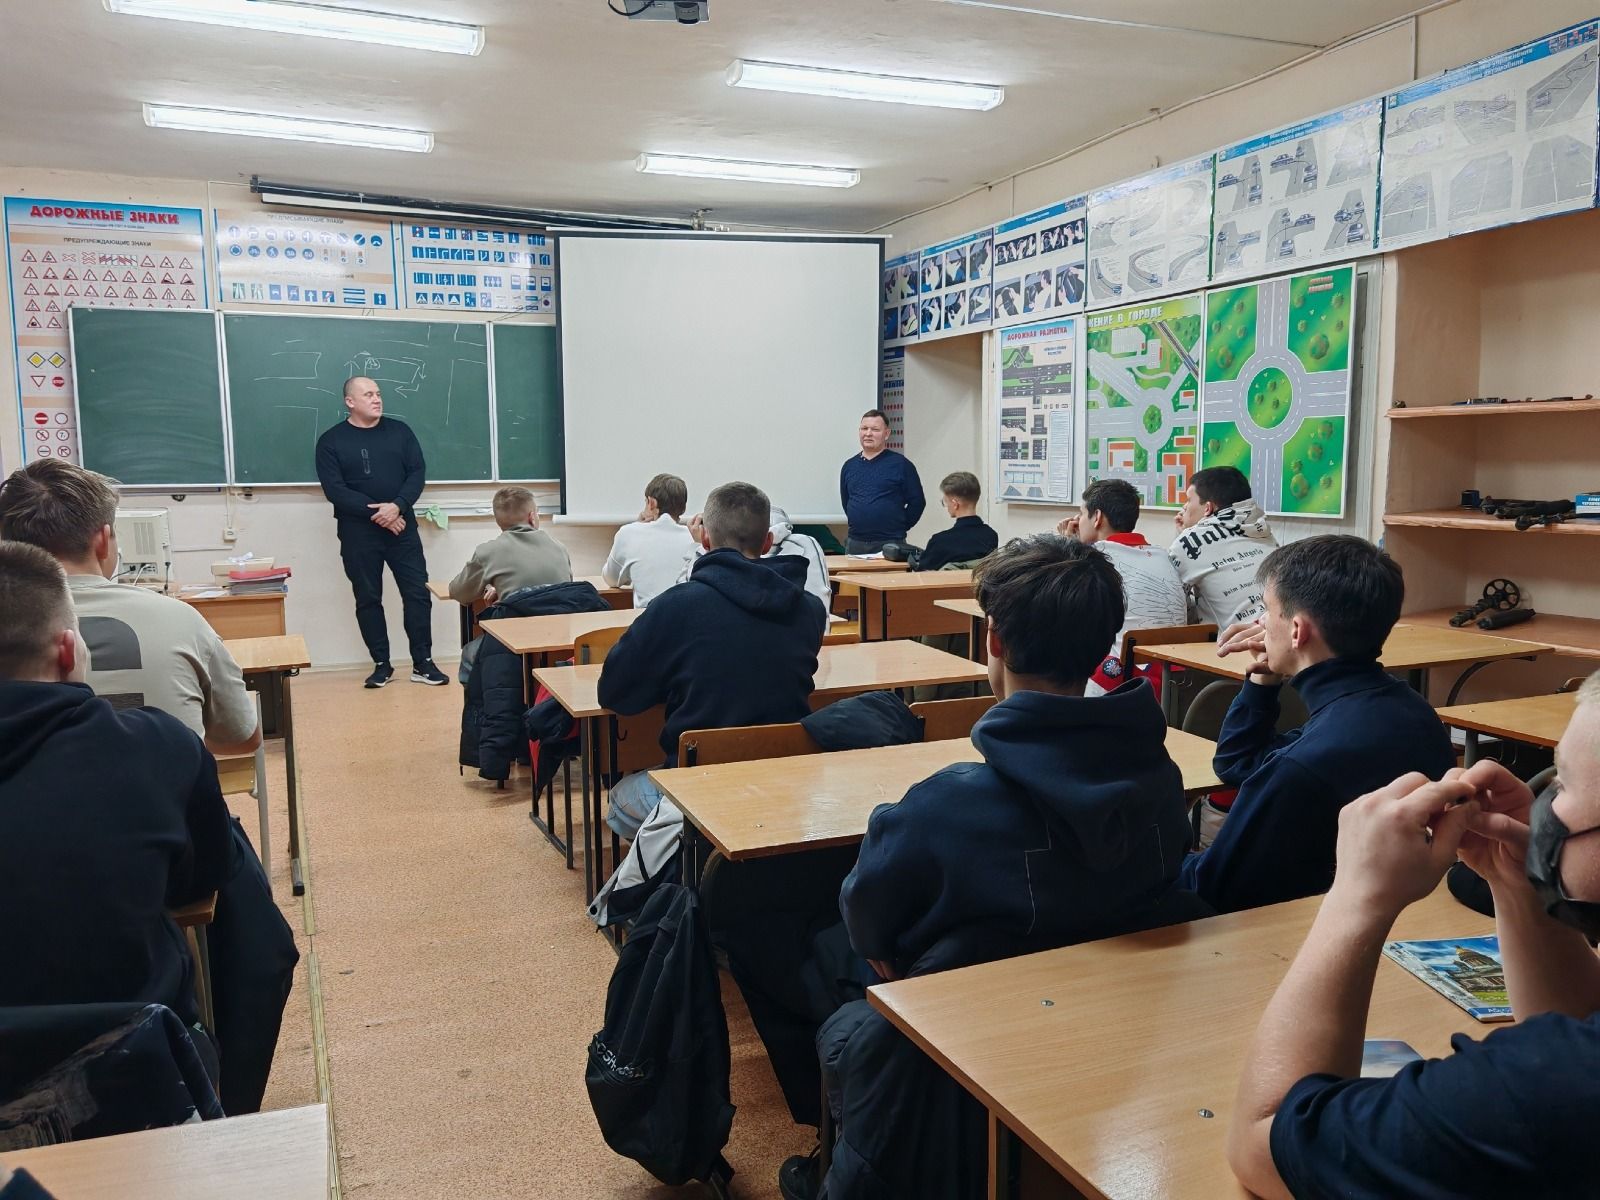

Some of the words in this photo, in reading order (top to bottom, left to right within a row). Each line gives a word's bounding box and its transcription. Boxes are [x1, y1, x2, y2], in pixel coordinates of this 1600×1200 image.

[30, 205, 124, 221] ДОРОЖНЫЕ
[130, 211, 179, 225] ЗНАКИ
[63, 237, 130, 246] ПРЕДУПРЕЖДАЮЩИЕ
[1117, 313, 1124, 322] В
[1128, 306, 1163, 321] ГОРОДЕ
[1007, 330, 1037, 341] ДОРОЖНАЯ
[1211, 556, 1236, 570] Palm
[1235, 608, 1257, 621] Palm
